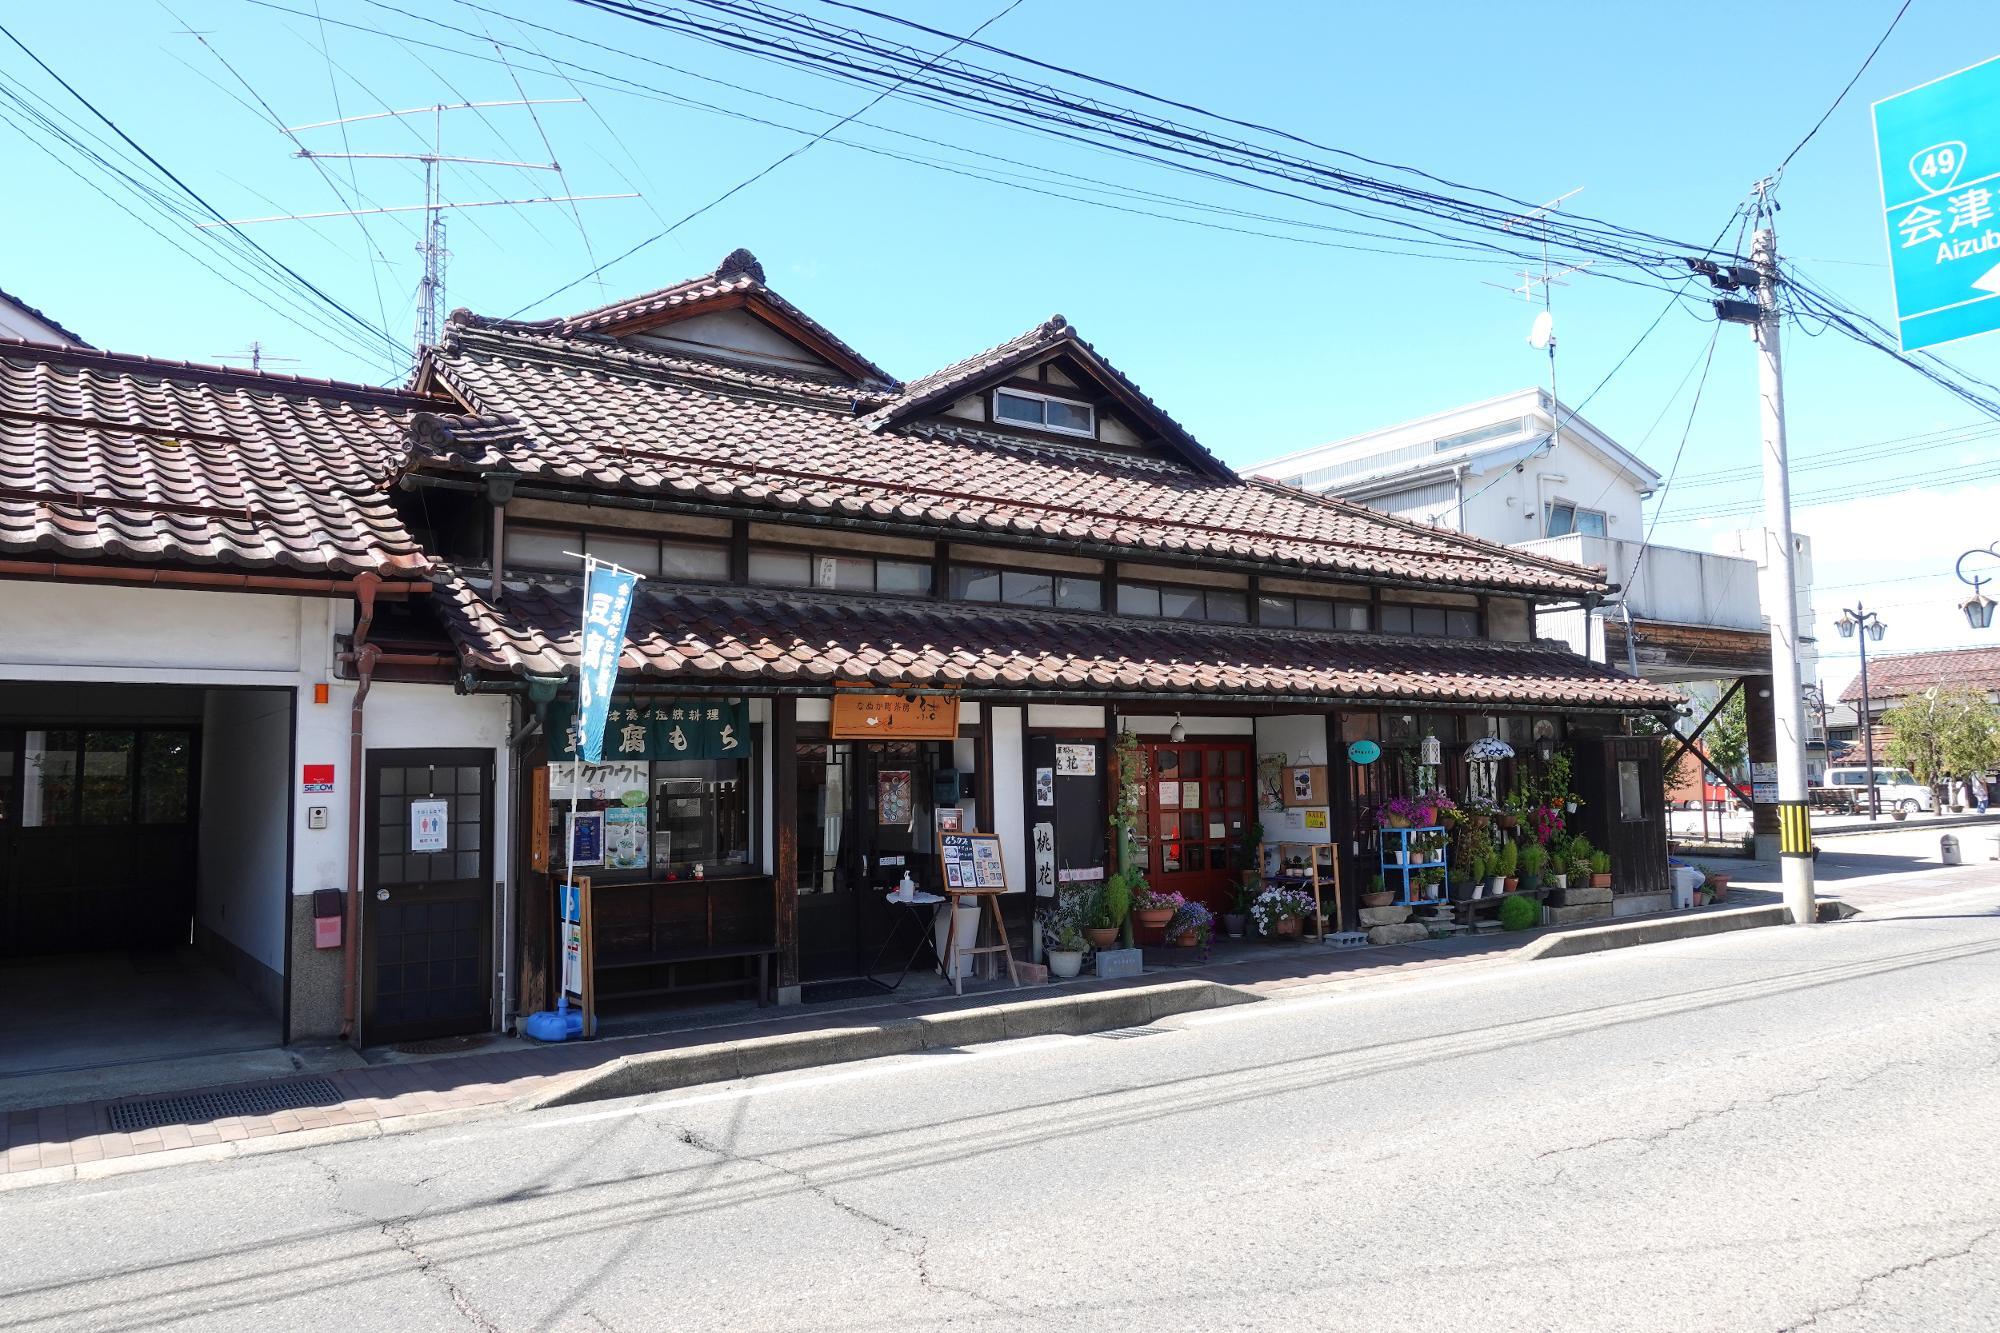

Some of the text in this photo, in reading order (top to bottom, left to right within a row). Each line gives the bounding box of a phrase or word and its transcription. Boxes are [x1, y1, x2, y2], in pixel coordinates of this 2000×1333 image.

[1920, 148, 1956, 178] 49
[1898, 187, 2000, 249] 会津
[304, 784, 333, 792] SECOM
[1036, 829, 1052, 886] 桃花
